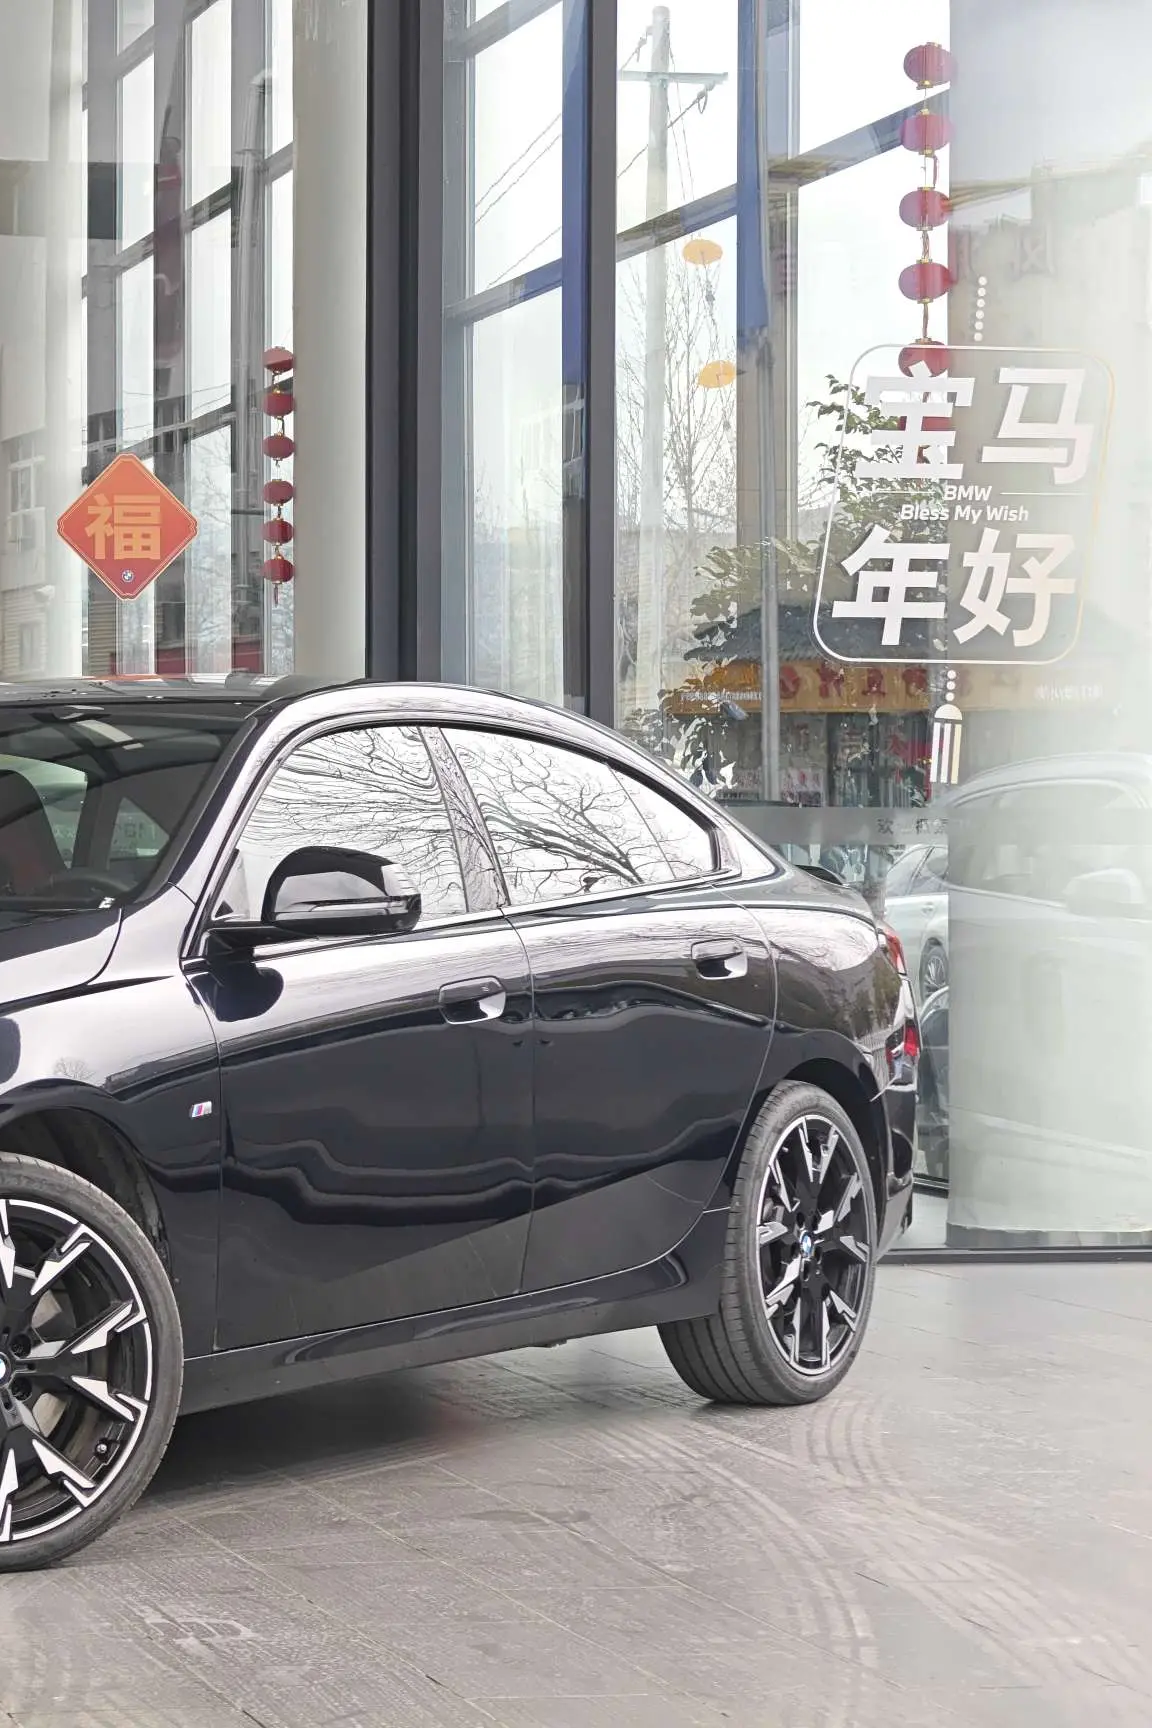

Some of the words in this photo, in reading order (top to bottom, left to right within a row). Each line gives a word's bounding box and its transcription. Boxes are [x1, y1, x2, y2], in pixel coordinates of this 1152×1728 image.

[855, 360, 1094, 485] 宝马
[901, 503, 950, 520] Bless
[954, 504, 982, 524] My
[987, 505, 1029, 521] Wish
[943, 484, 992, 501] BMW
[84, 493, 162, 560] 福
[831, 524, 1077, 647] 年好
